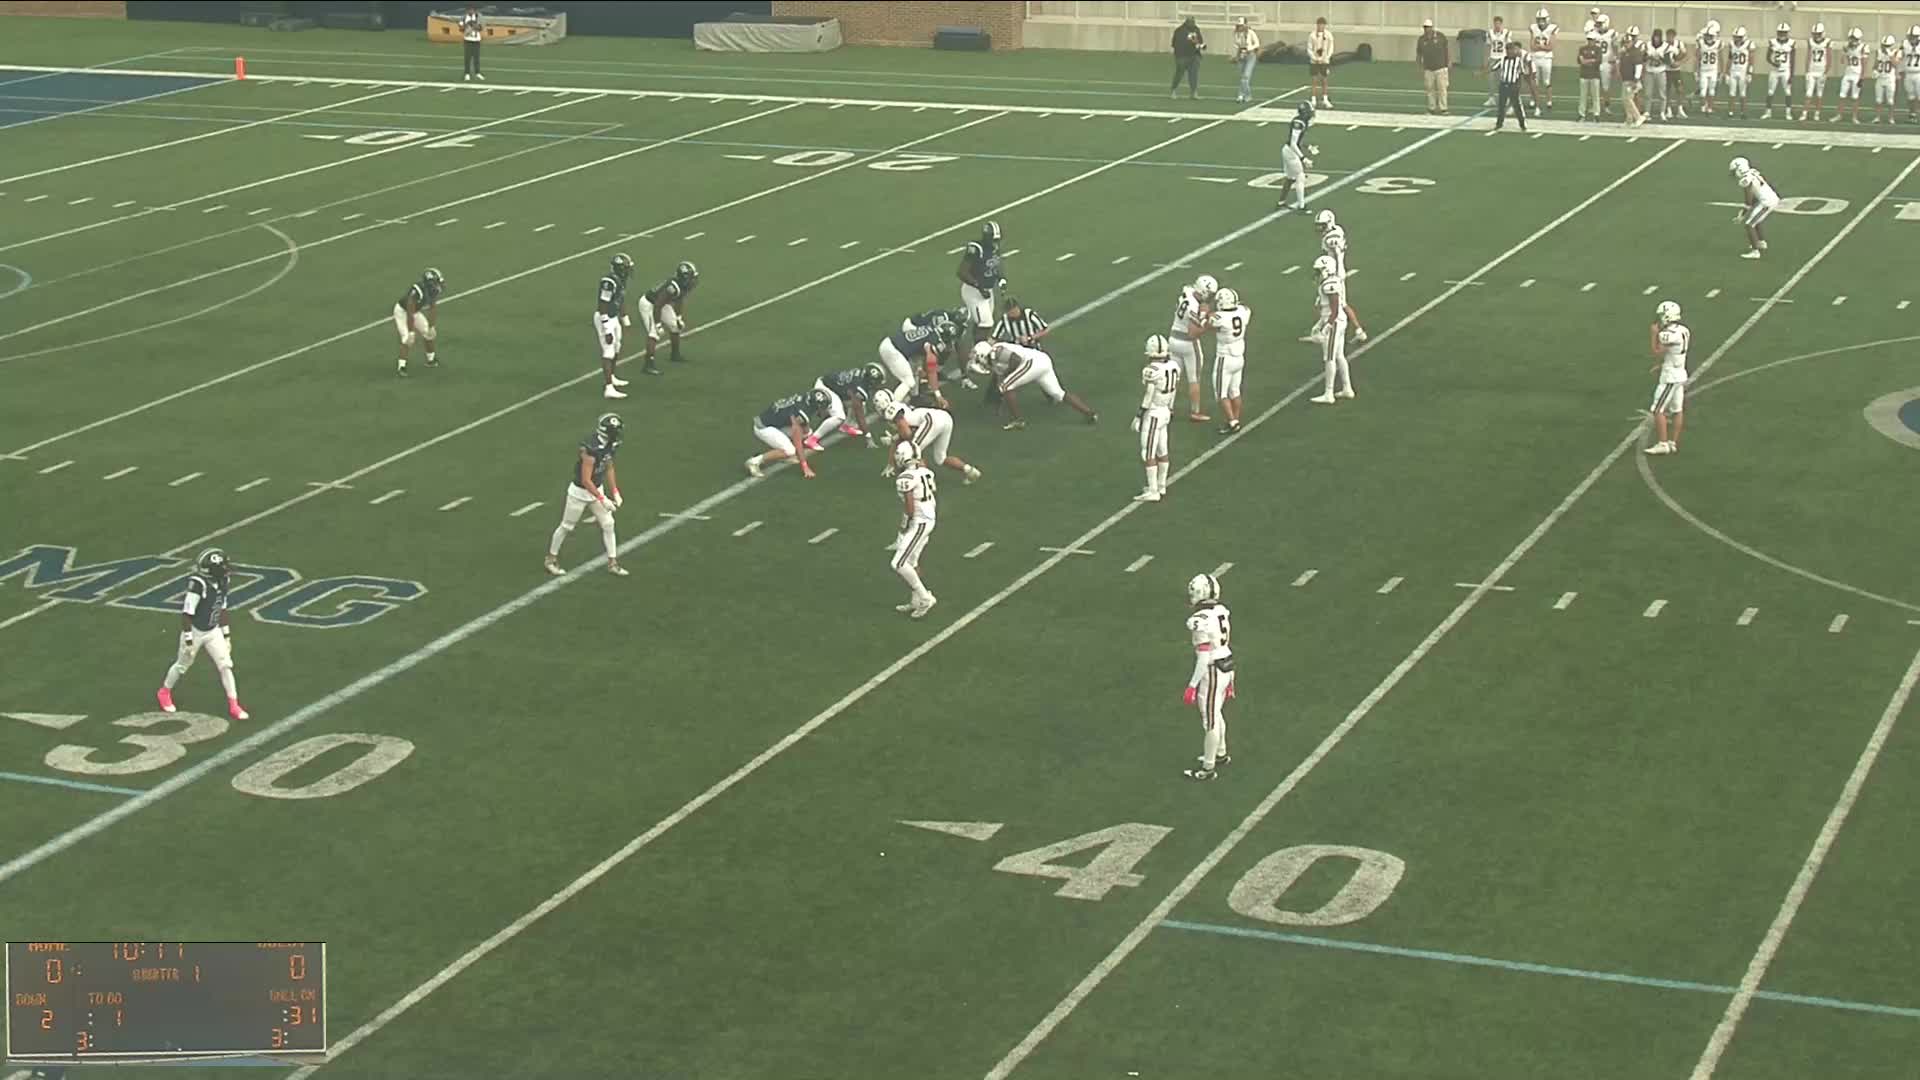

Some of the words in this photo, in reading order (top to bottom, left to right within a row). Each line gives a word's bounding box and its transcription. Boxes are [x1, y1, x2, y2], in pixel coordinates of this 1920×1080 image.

[1231, 316, 1243, 337] 9
[1217, 614, 1229, 647] 5
[43, 711, 416, 800] 30
[991, 821, 1407, 927] 40
